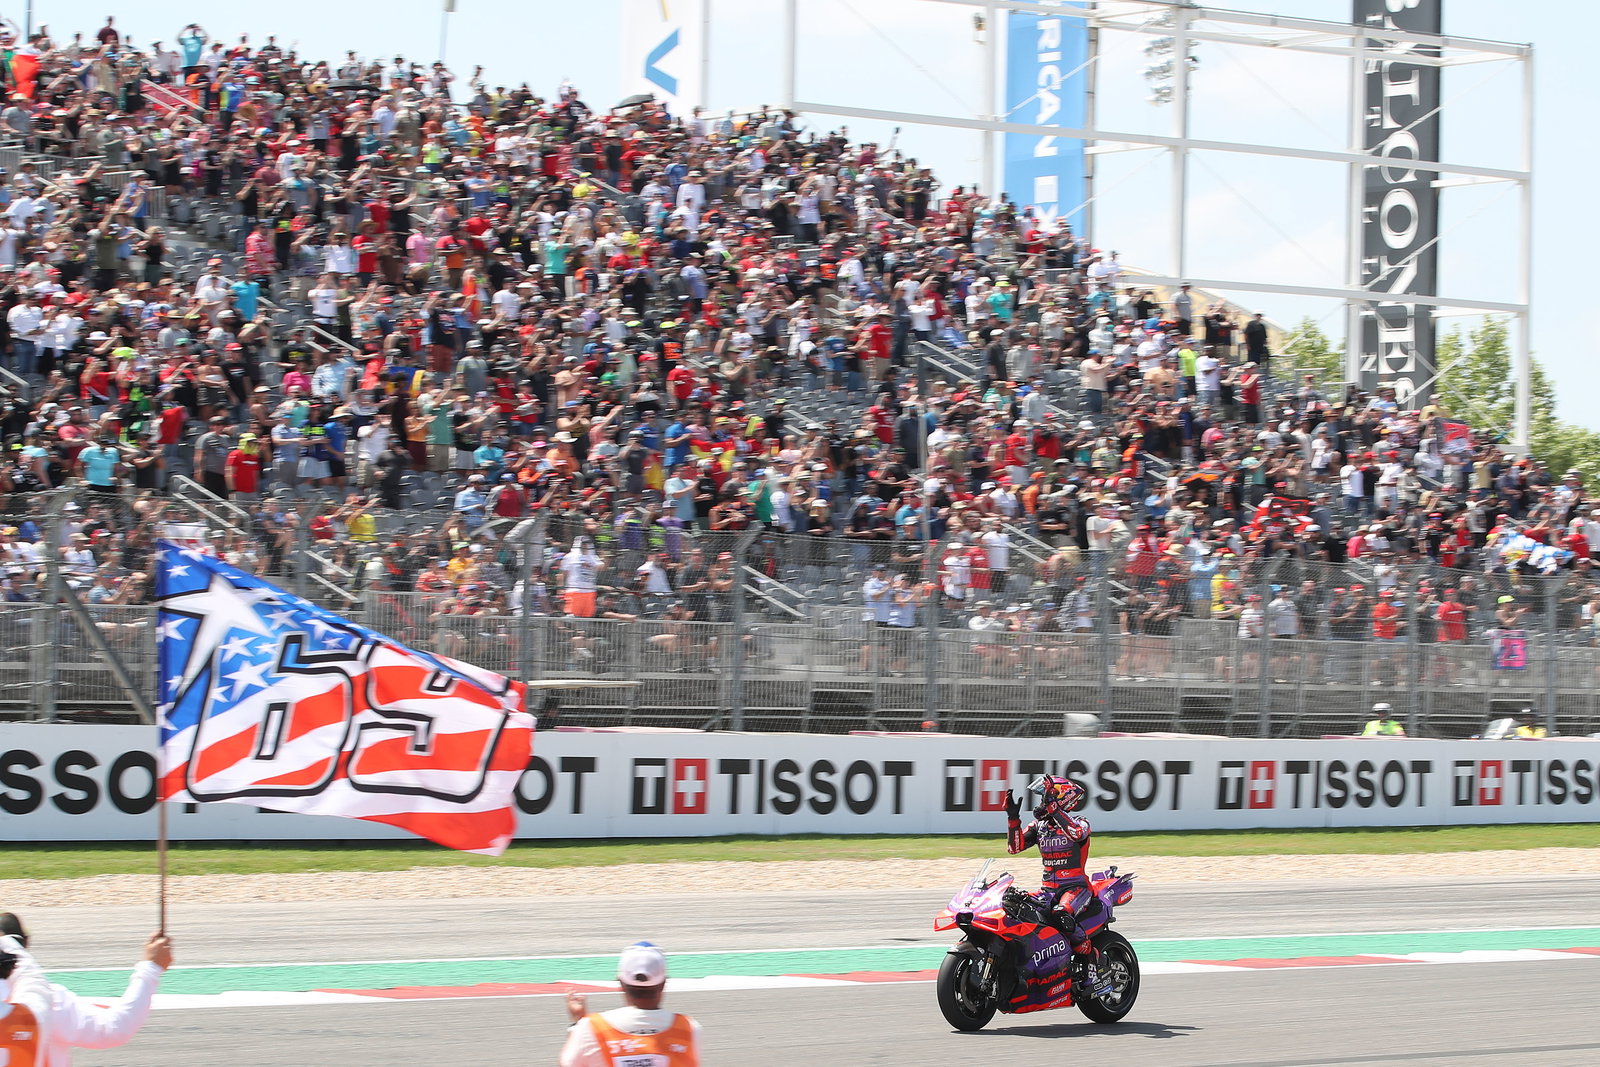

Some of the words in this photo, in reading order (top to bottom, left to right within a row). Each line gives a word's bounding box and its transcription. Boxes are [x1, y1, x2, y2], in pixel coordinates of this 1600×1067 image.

[1034, 0, 1062, 157] RICAN
[0, 750, 198, 814] SSO
[718, 758, 915, 815] TISSOT
[1285, 760, 1432, 808] TISSOT
[1510, 759, 1600, 804] TISS
[1039, 836, 1068, 849] prima
[1032, 940, 1066, 967] prima
